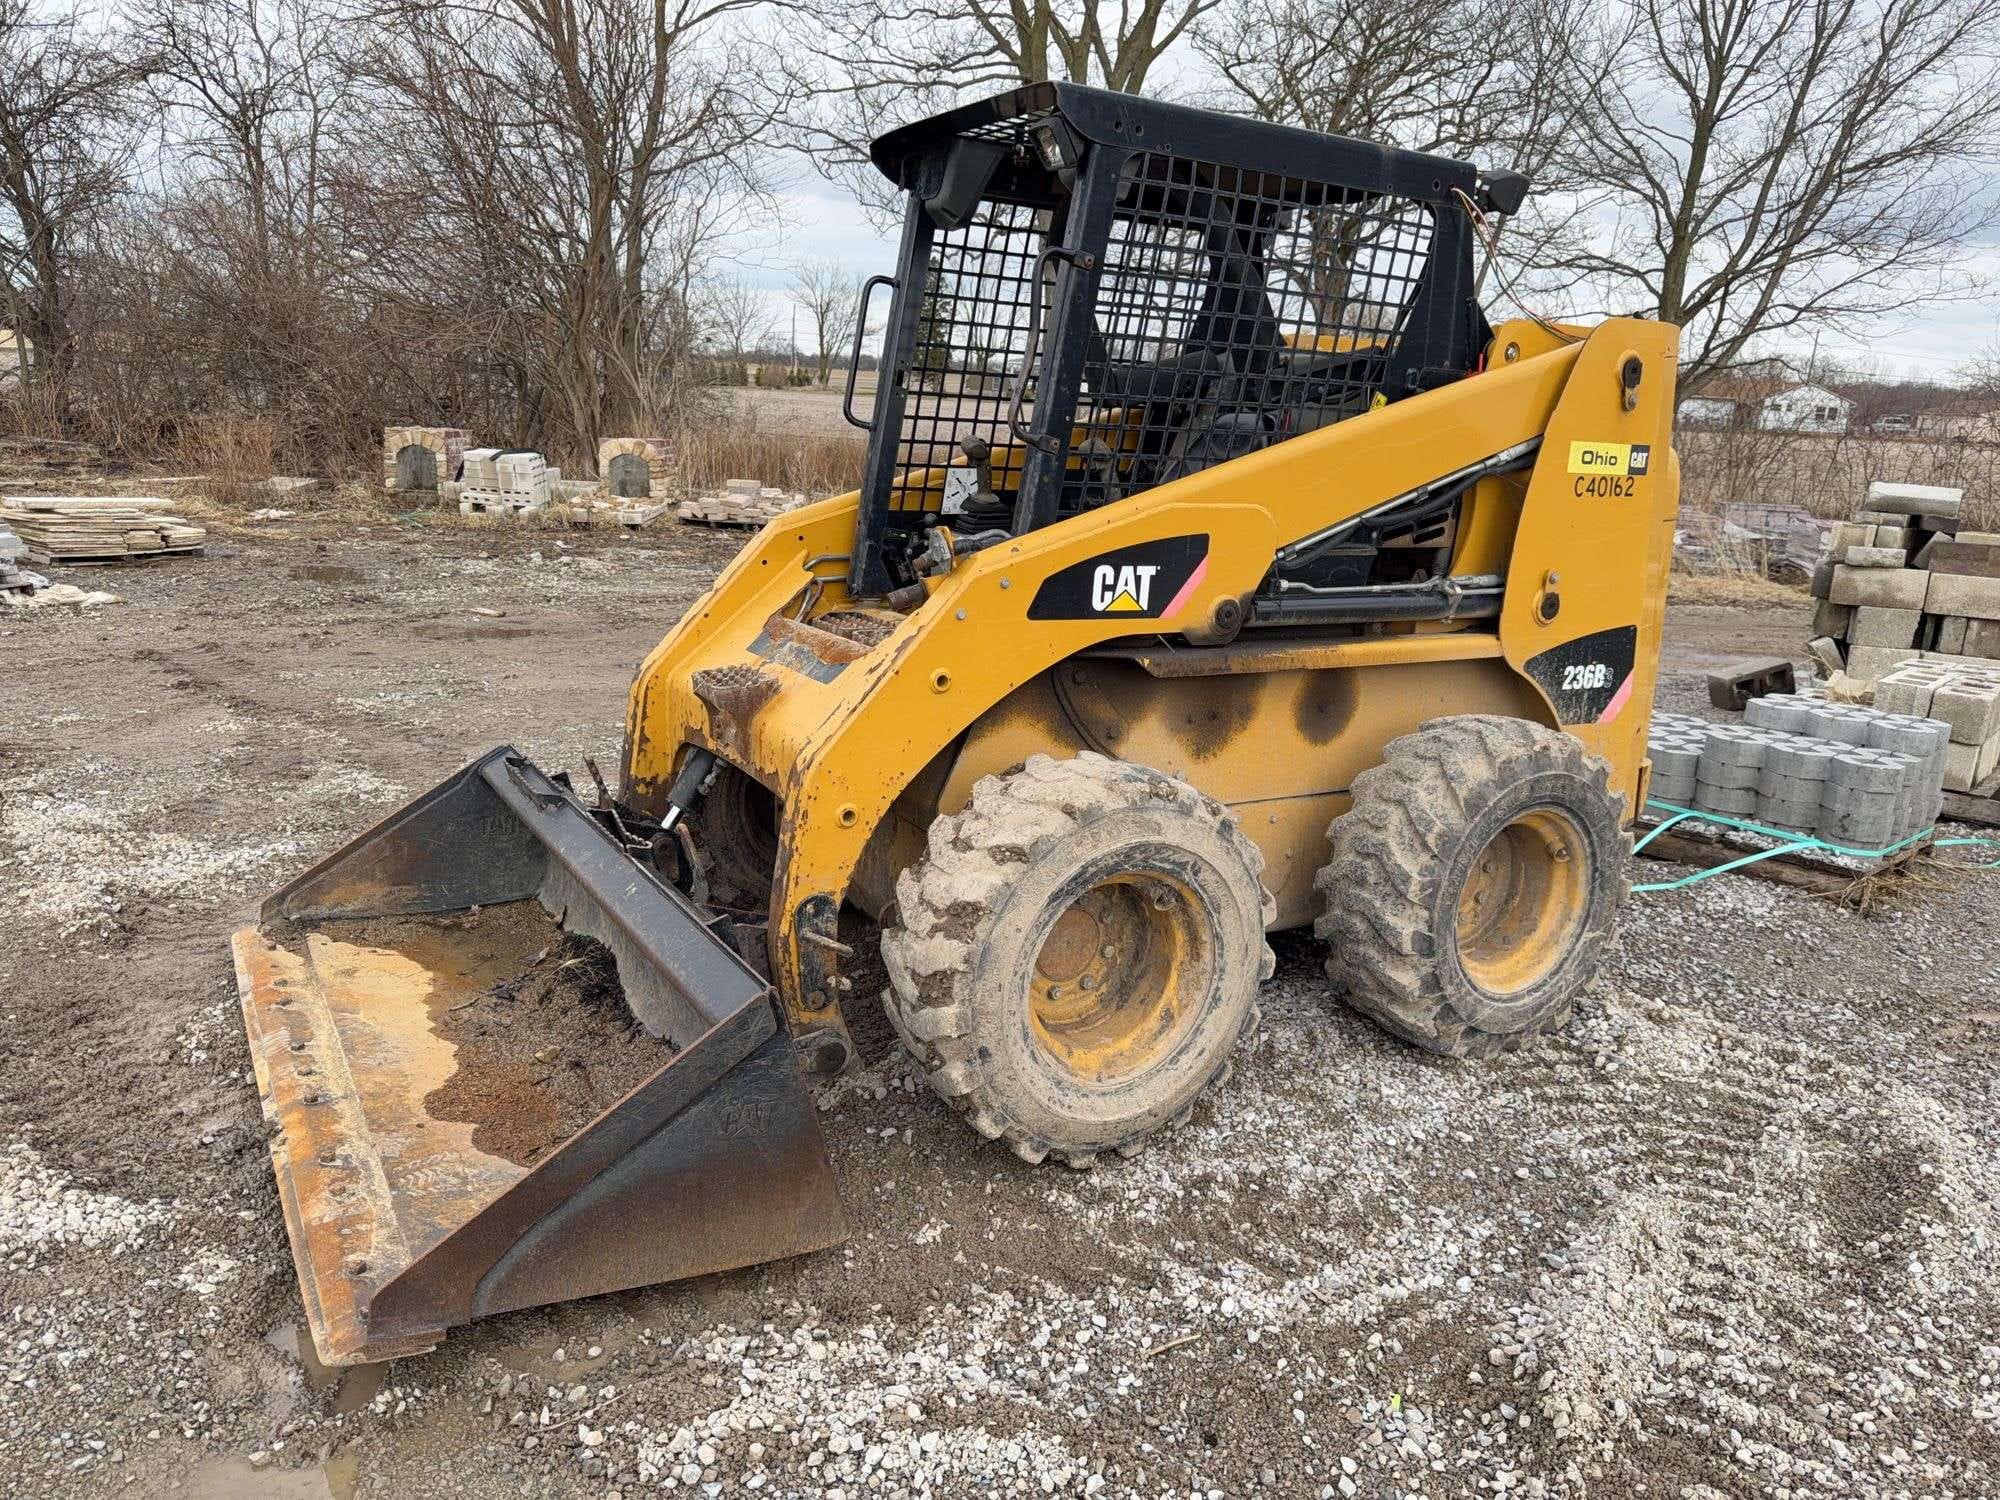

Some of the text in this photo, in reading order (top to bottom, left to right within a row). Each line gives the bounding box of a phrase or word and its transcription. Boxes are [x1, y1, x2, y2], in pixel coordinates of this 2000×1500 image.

[1581, 450, 1648, 468] Ohio CAT
[1574, 475, 1635, 497] C40162
[1092, 564, 1157, 612] CAT
